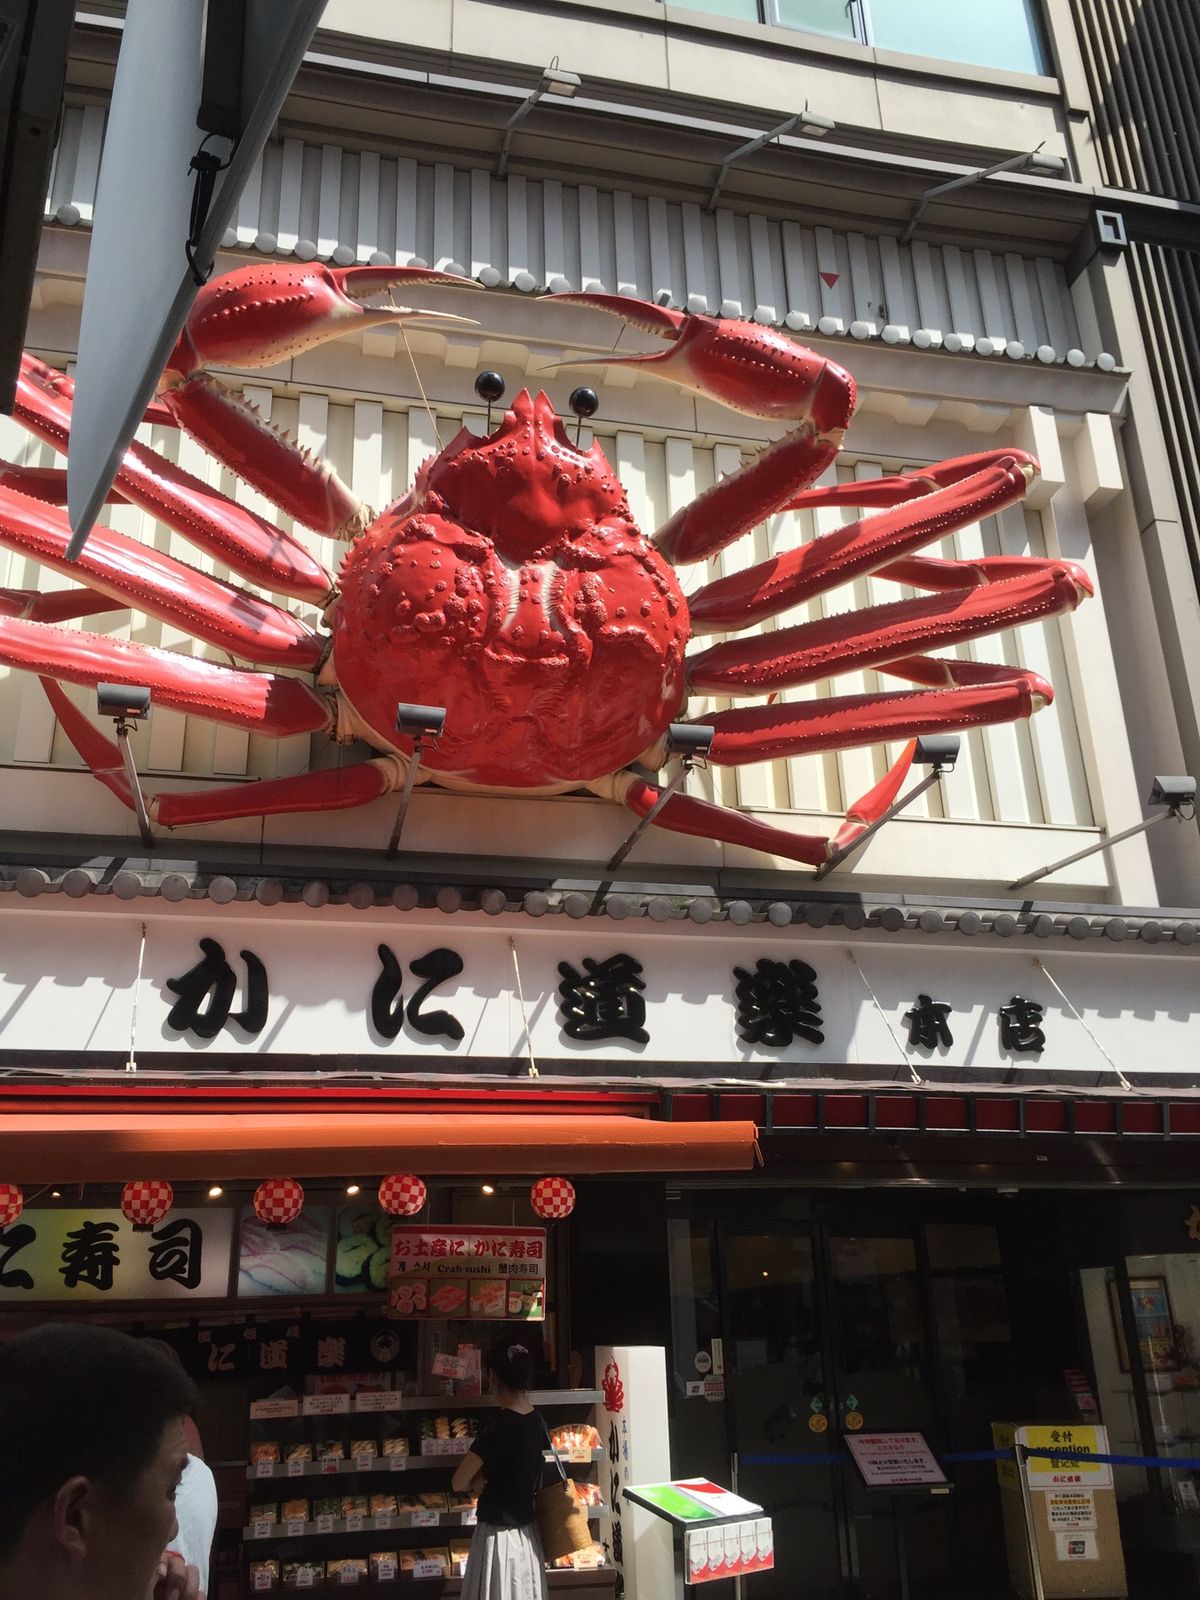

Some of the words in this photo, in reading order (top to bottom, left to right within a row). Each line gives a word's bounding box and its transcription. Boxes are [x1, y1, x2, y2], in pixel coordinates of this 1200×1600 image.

[904, 993, 1046, 1053] 本店
[437, 1265, 462, 1273] Crab
[465, 1265, 491, 1274] sushi
[1050, 1430, 1073, 1442] 受付
[1036, 1444, 1090, 1453] ception
